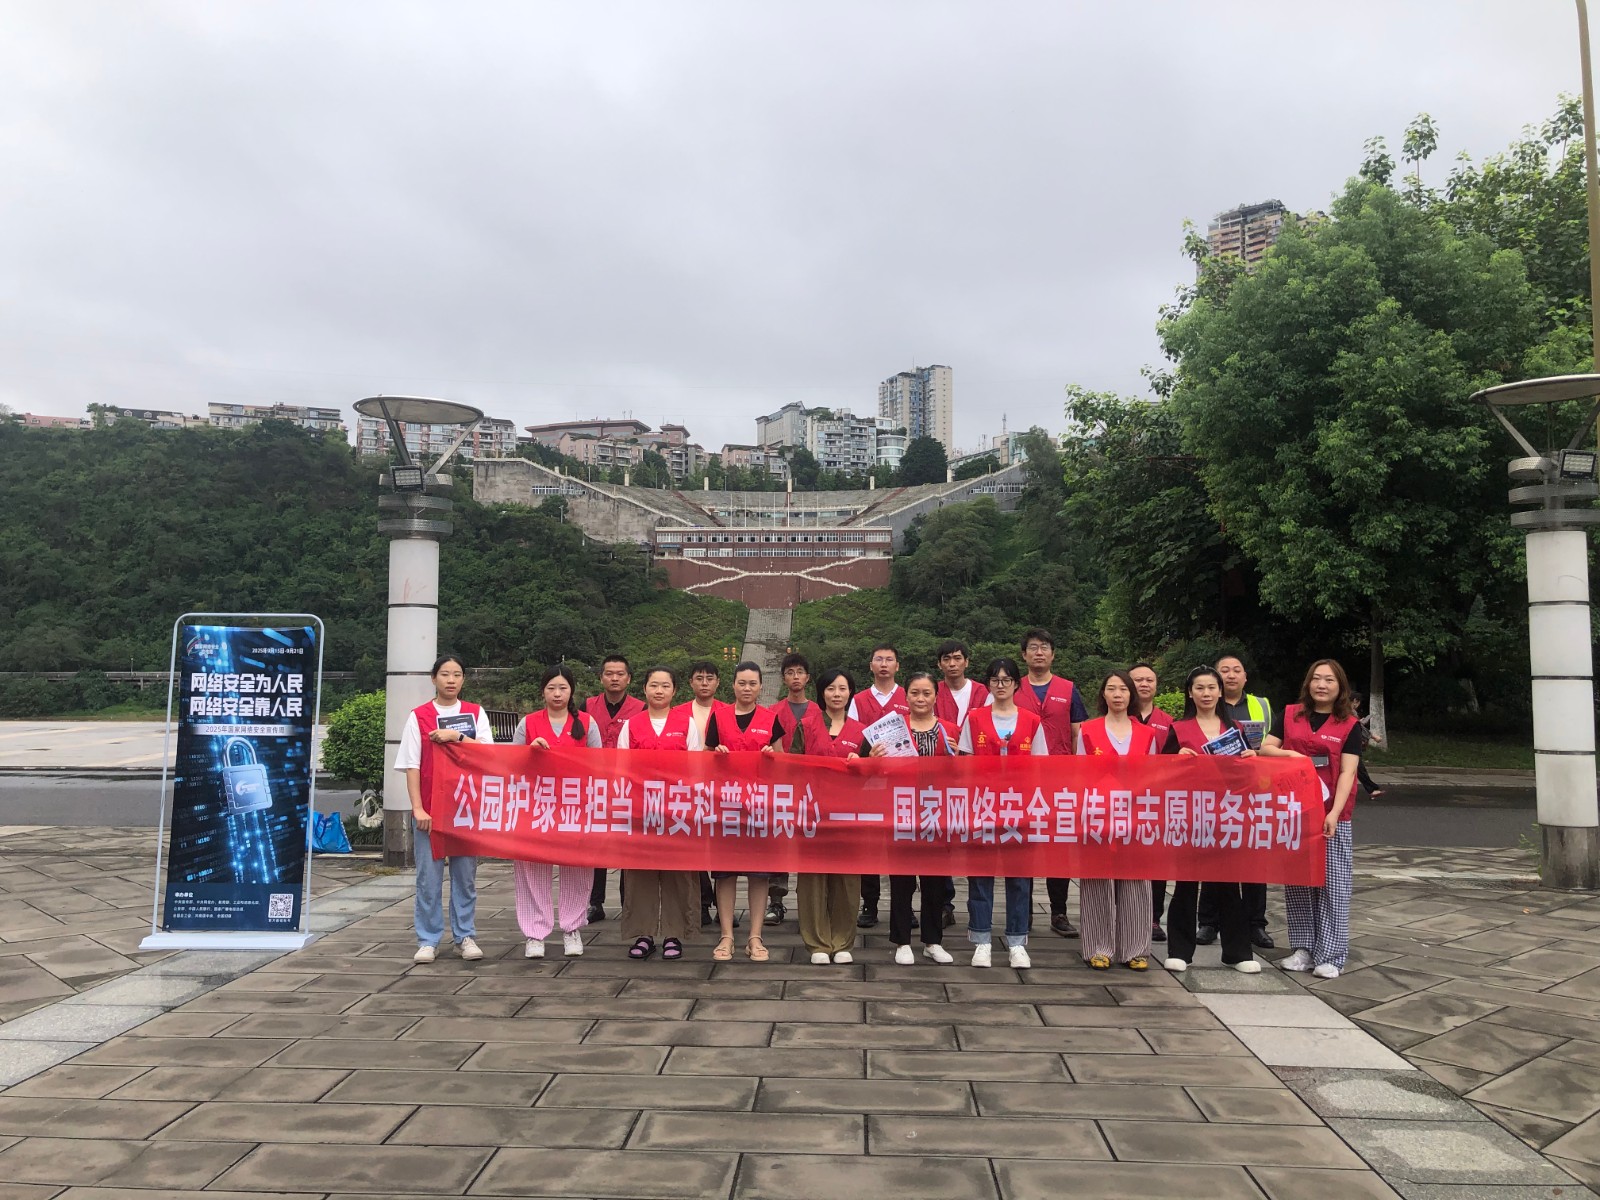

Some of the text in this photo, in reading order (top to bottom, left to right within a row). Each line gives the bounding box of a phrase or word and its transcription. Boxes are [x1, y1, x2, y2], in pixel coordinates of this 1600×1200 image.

[251, 647, 304, 655] 2025年9月15日-9月21日
[190, 672, 303, 694] 网络安全为人民
[189, 696, 303, 718] 网络安全靠人民
[205, 725, 285, 734] 2025年国家网络安全宣传周
[453, 774, 633, 836] 公园护绿显担当
